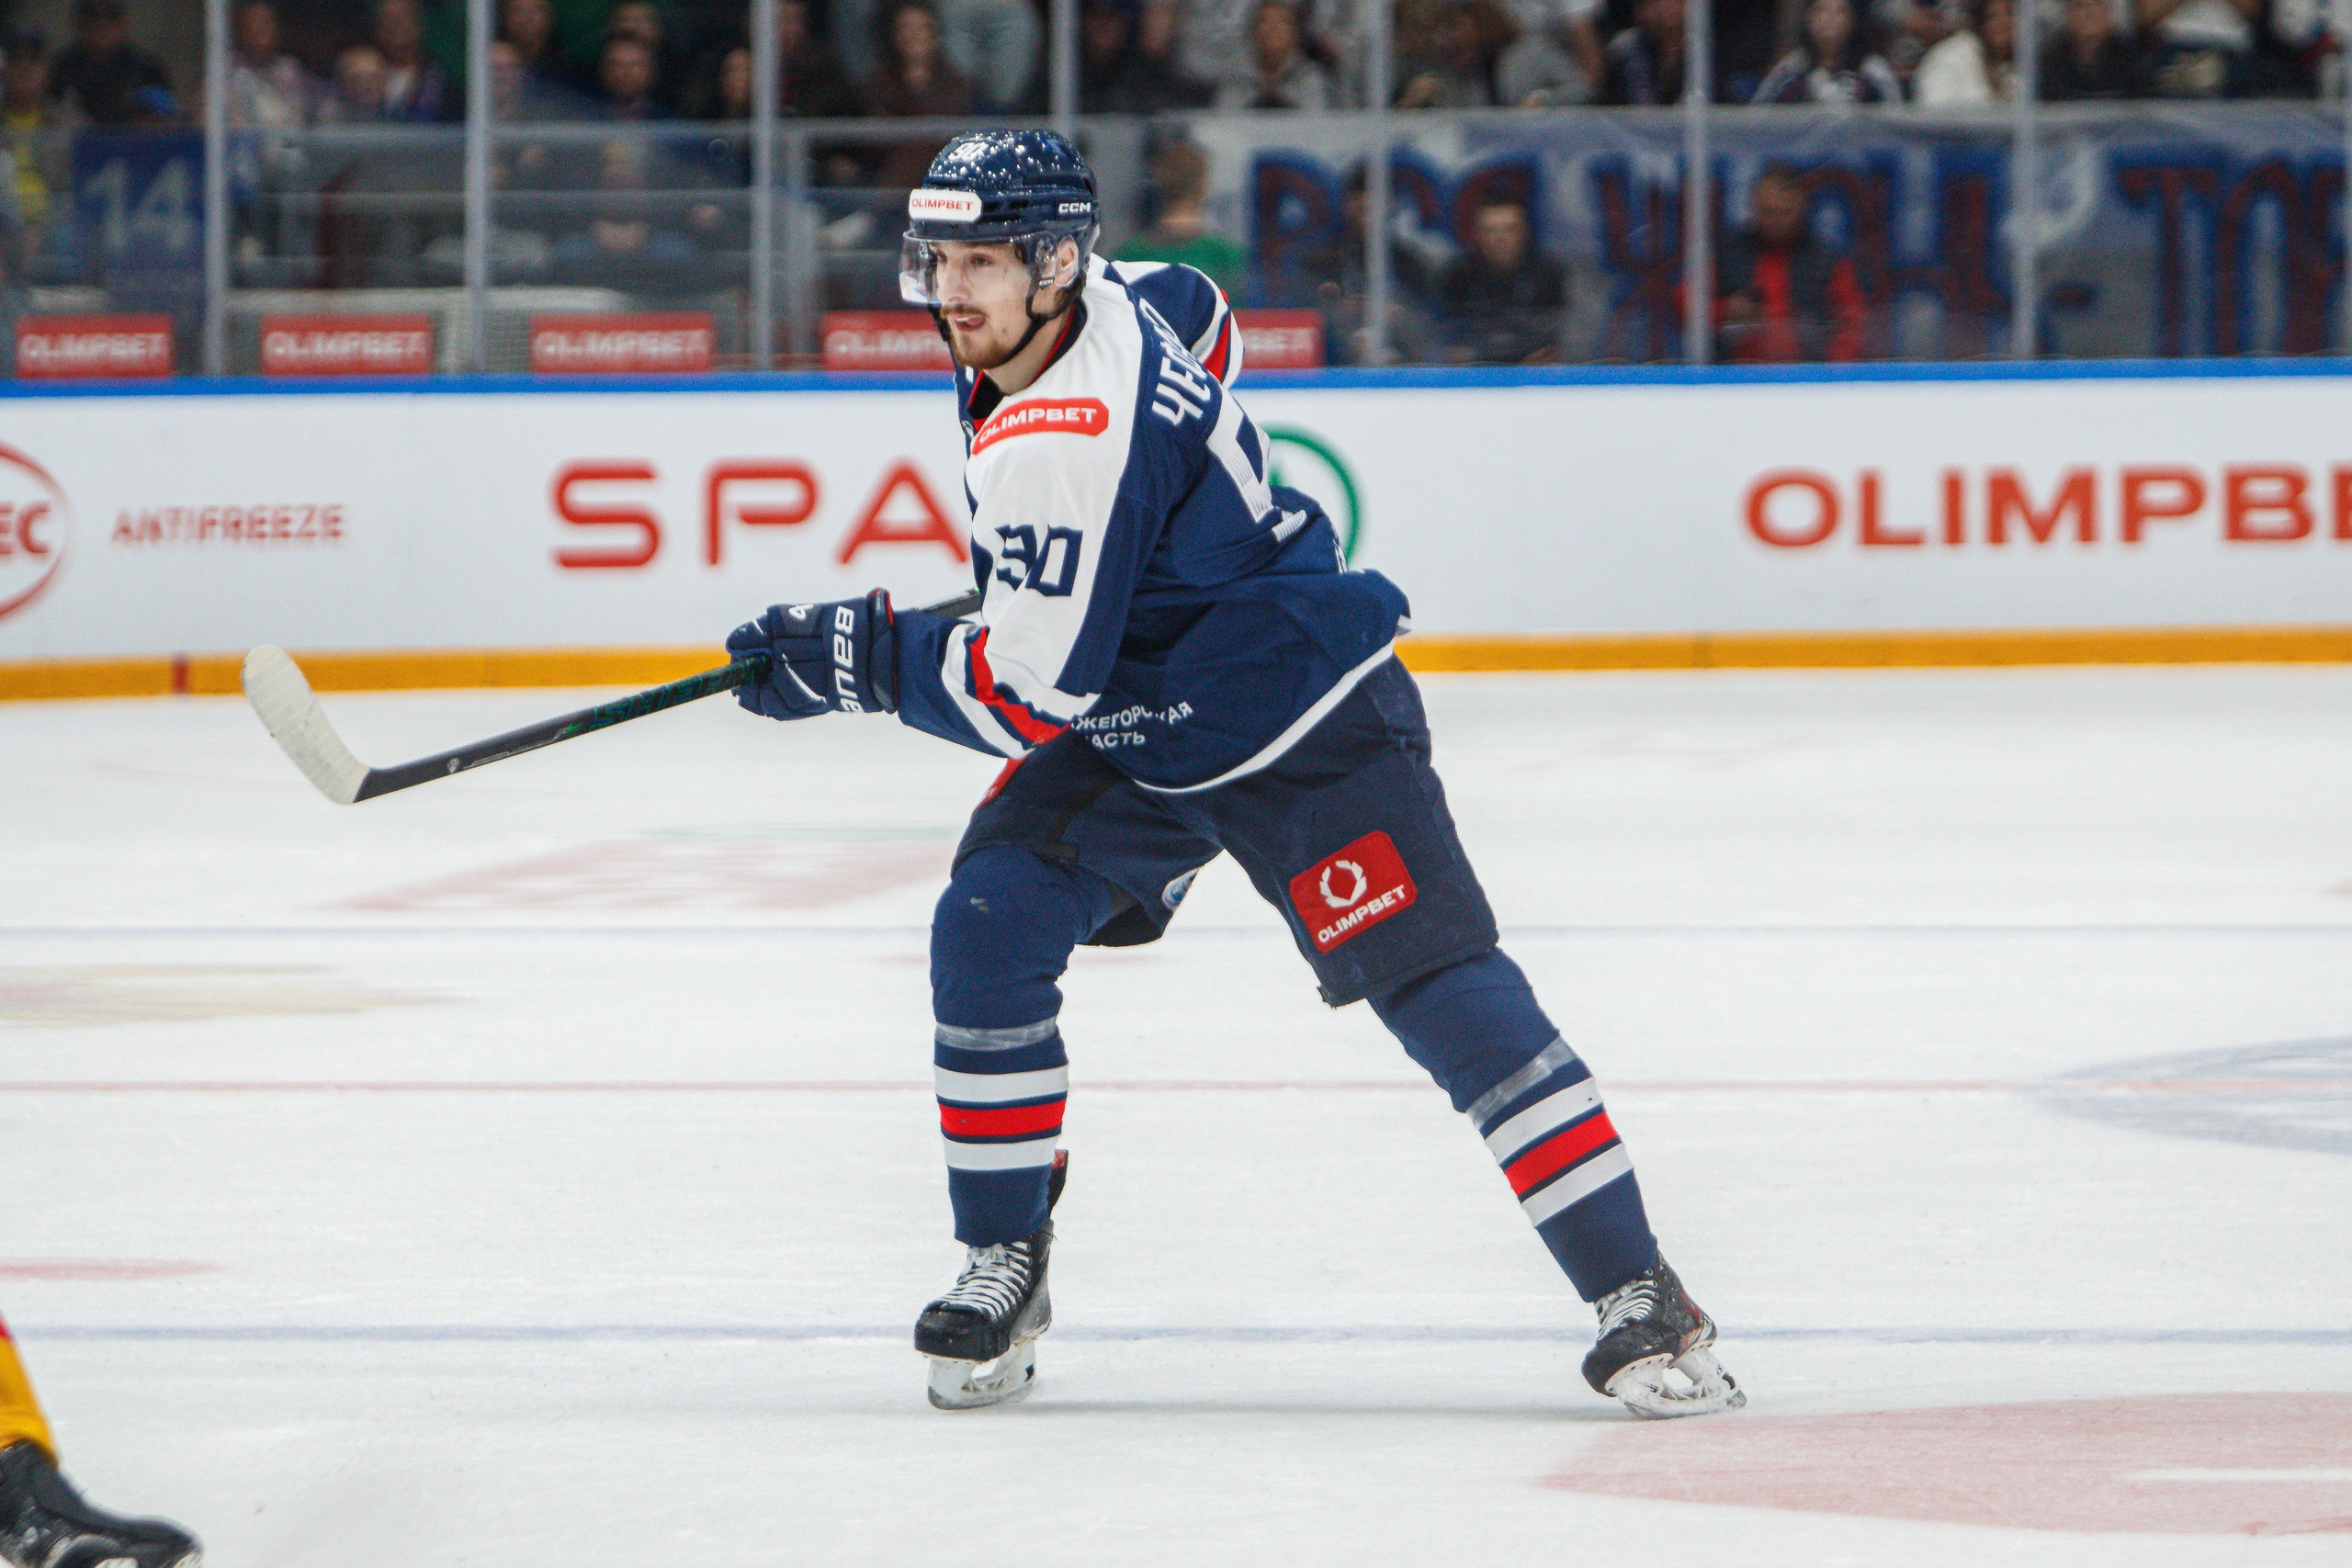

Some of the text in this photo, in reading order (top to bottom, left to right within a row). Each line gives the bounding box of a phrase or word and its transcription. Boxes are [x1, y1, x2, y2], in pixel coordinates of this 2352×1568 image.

[83, 156, 195, 250] 14
[910, 197, 974, 212] OLIMPBET
[1057, 201, 1091, 214] CCM
[16, 331, 169, 361] OLIMPBET
[263, 329, 429, 359] OLIMPBET
[532, 327, 708, 357] OLIMPBET
[978, 407, 1098, 444] OLIMPBET
[549, 459, 970, 573] SPA
[1742, 462, 2352, 549] OLIMPB
[111, 504, 346, 547] ANTIFREEZE
[1317, 884, 1407, 943] OLIMPBET
